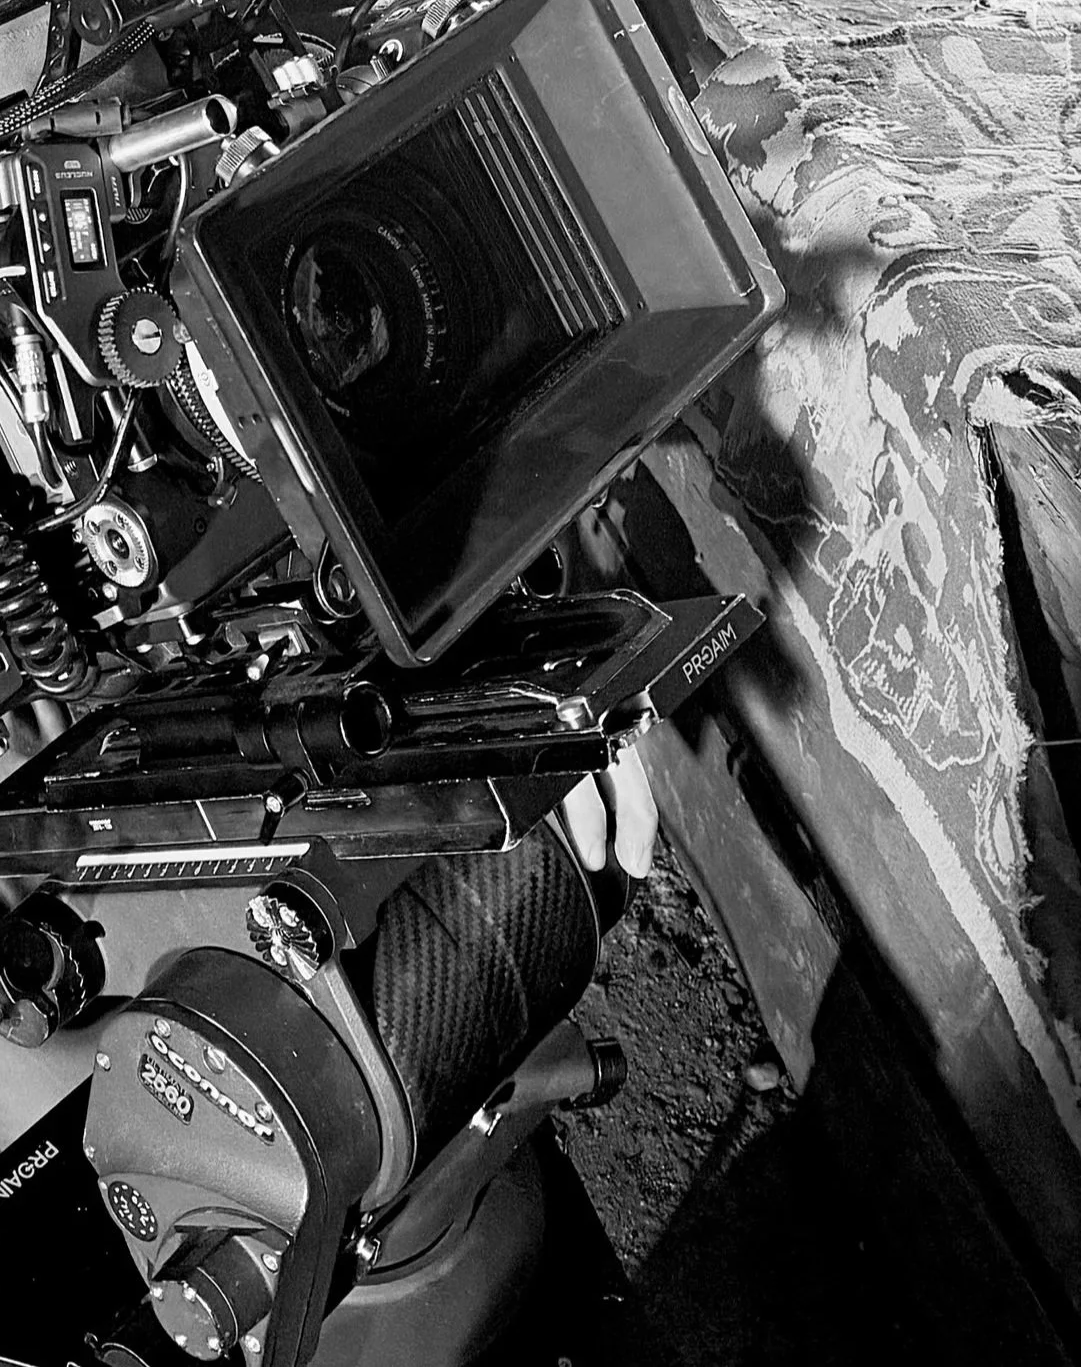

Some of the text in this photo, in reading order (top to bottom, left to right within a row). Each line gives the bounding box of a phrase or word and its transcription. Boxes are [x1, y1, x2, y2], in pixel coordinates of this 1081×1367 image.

[55, 171, 93, 179] NUCLEUS
[377, 225, 401, 250] CANON
[410, 264, 425, 289] LENS
[421, 293, 433, 320] MADE
[423, 341, 434, 370] JAPAN
[682, 622, 737, 684] PROAIM
[142, 1063, 191, 1116] 2560
